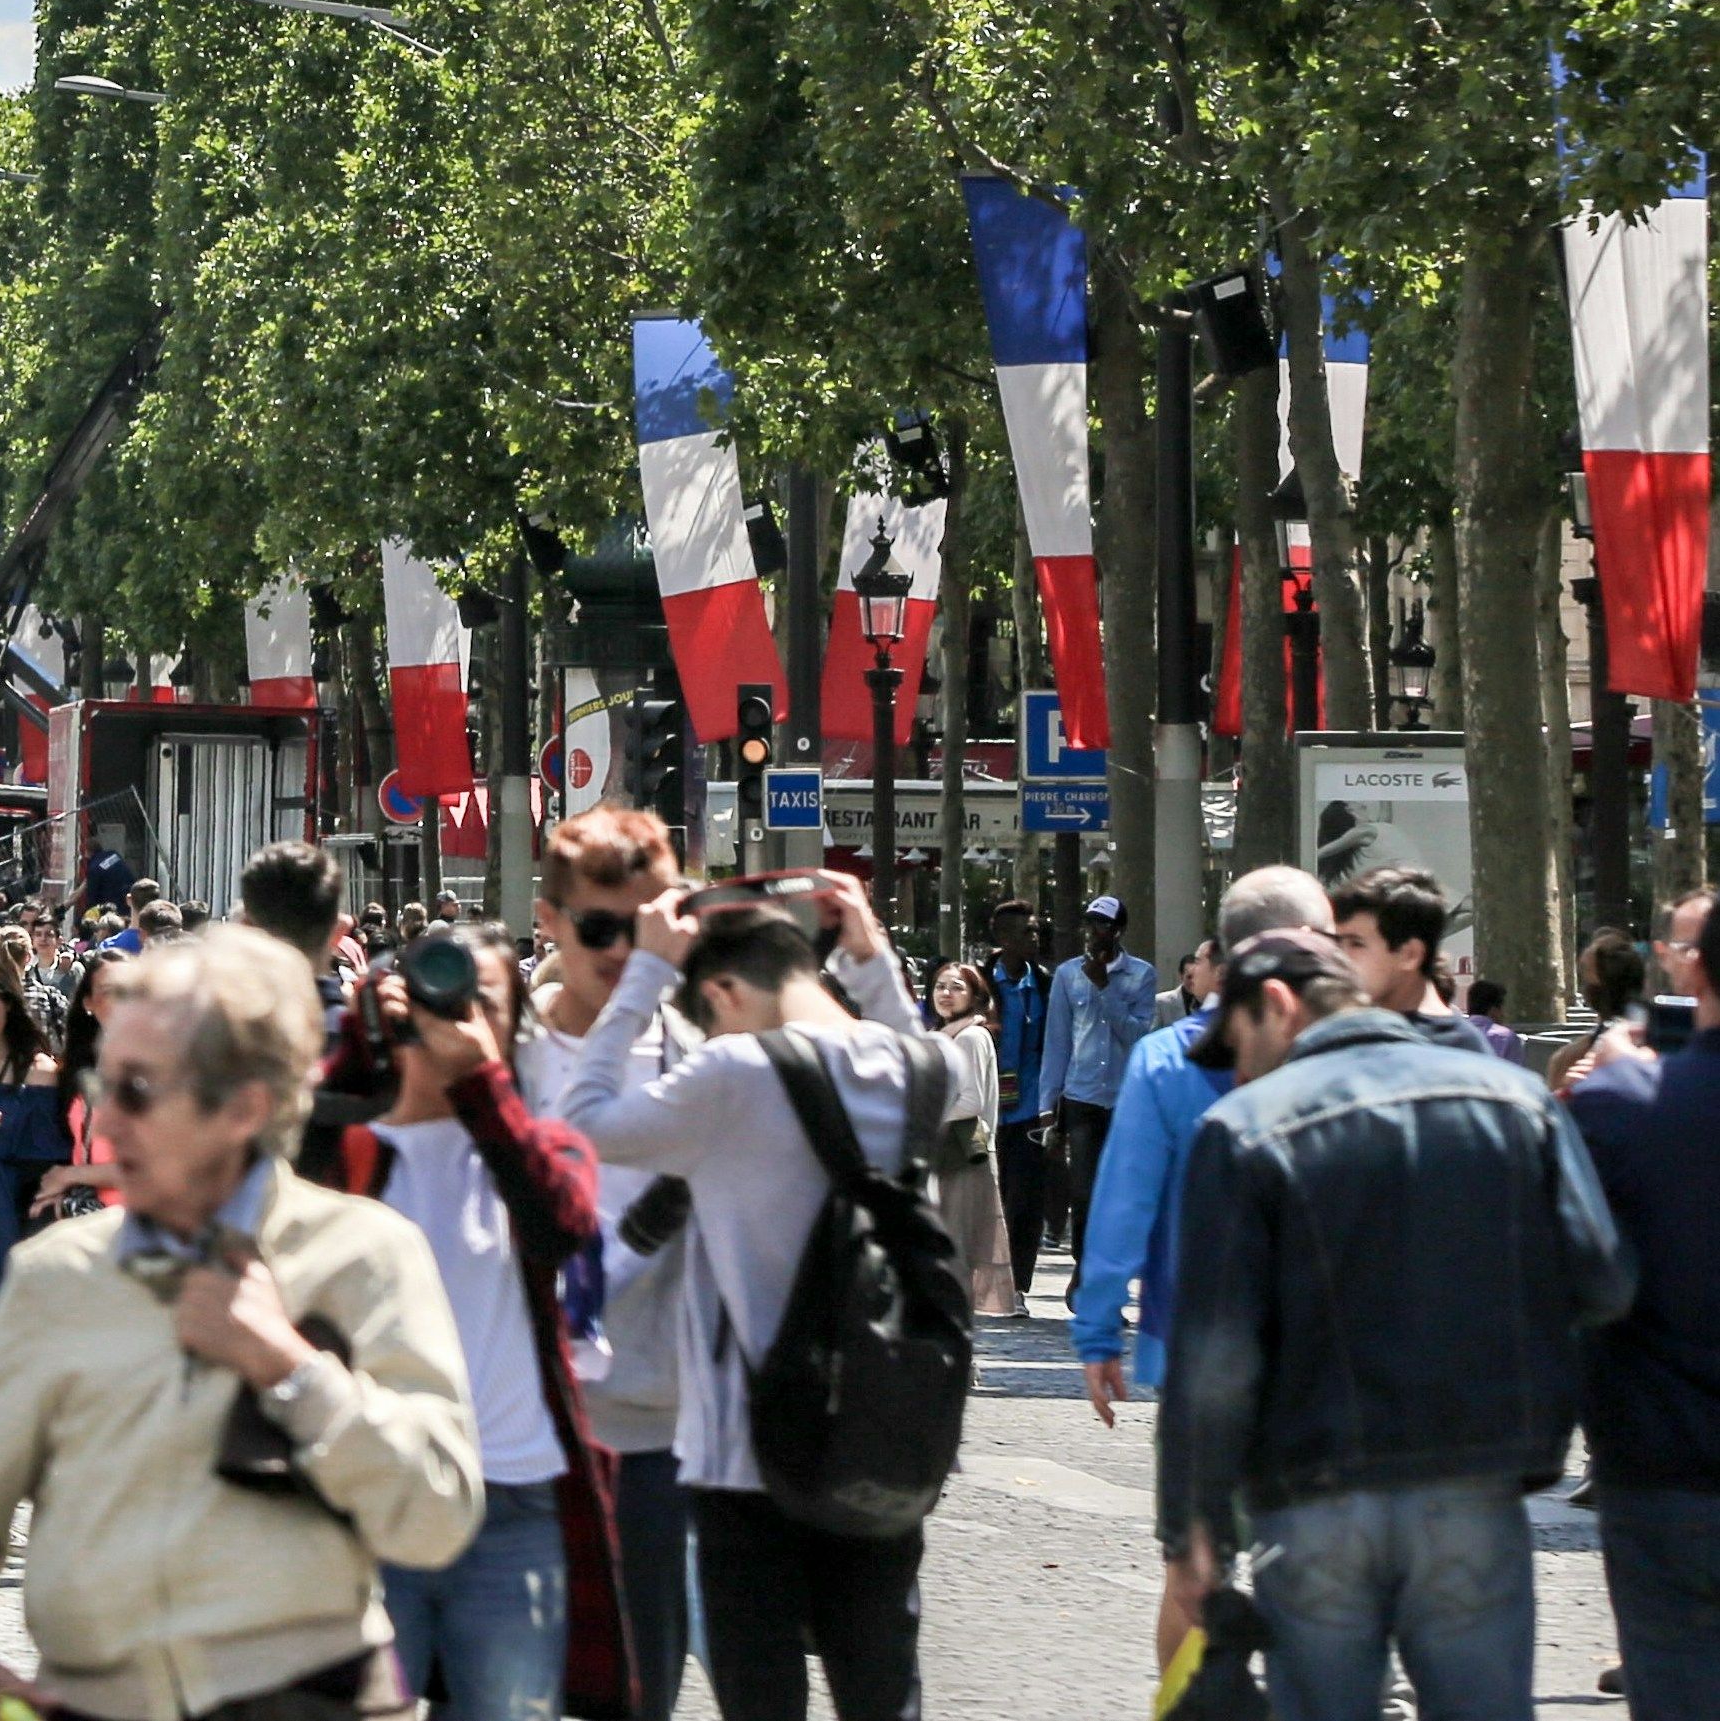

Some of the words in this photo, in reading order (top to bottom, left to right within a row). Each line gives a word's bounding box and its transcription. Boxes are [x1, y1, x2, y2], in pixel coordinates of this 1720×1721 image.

[1345, 774, 1423, 787] LACOSTE
[769, 792, 818, 808] TAXIS
[1024, 792, 1059, 802] PIERRE
